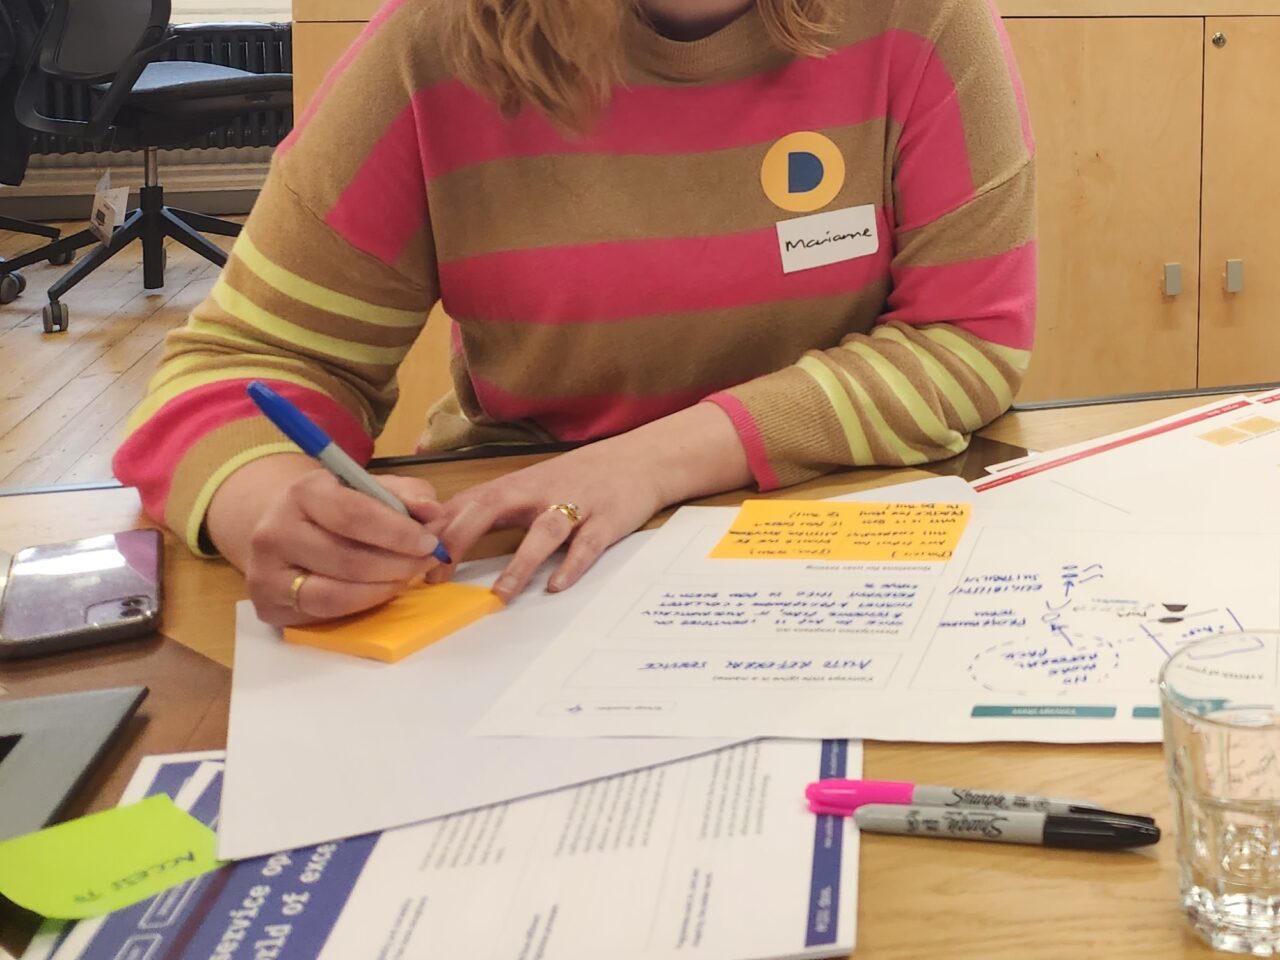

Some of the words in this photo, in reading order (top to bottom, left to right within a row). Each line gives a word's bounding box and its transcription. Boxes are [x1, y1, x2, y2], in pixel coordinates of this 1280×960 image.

[784, 227, 873, 253] Marianne
[944, 787, 1009, 810] Sharpie
[941, 815, 1010, 838] Sharpie
[282, 891, 310, 916] of
